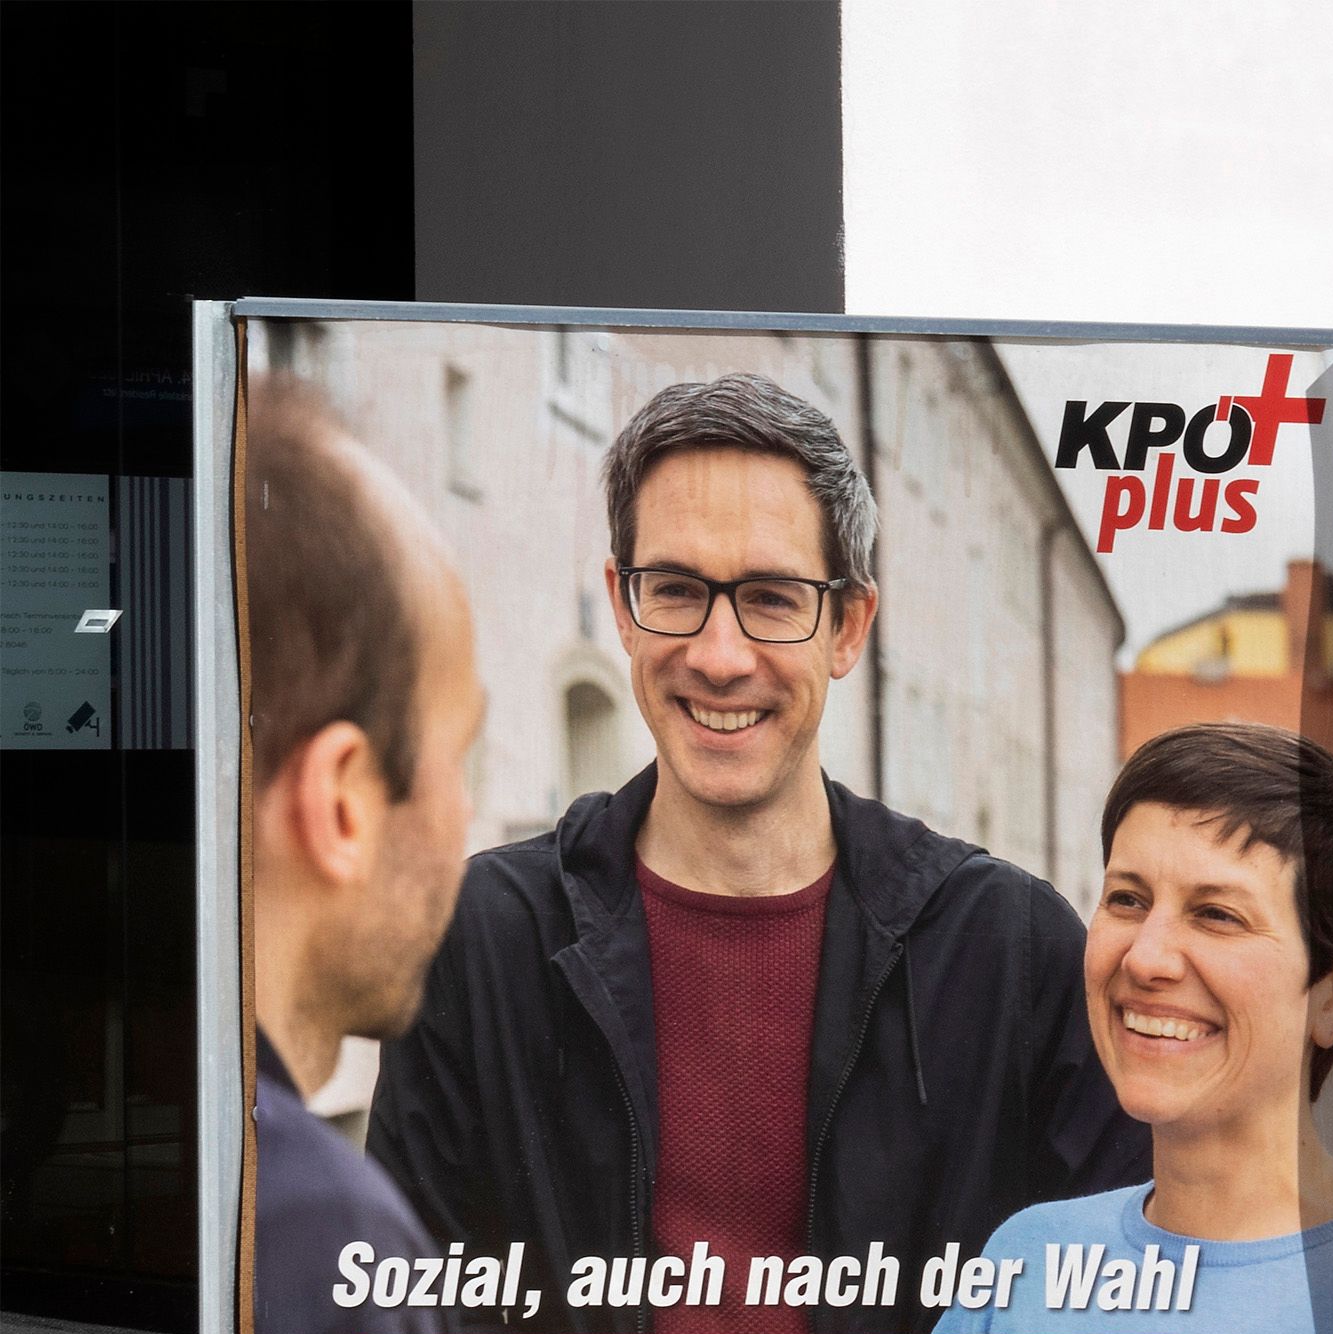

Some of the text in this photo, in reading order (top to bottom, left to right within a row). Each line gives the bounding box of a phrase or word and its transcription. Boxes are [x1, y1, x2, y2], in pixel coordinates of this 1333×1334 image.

[1097, 453, 1260, 552] plus
[333, 1241, 1199, 1318] Sozial, auch nach der Wahl
